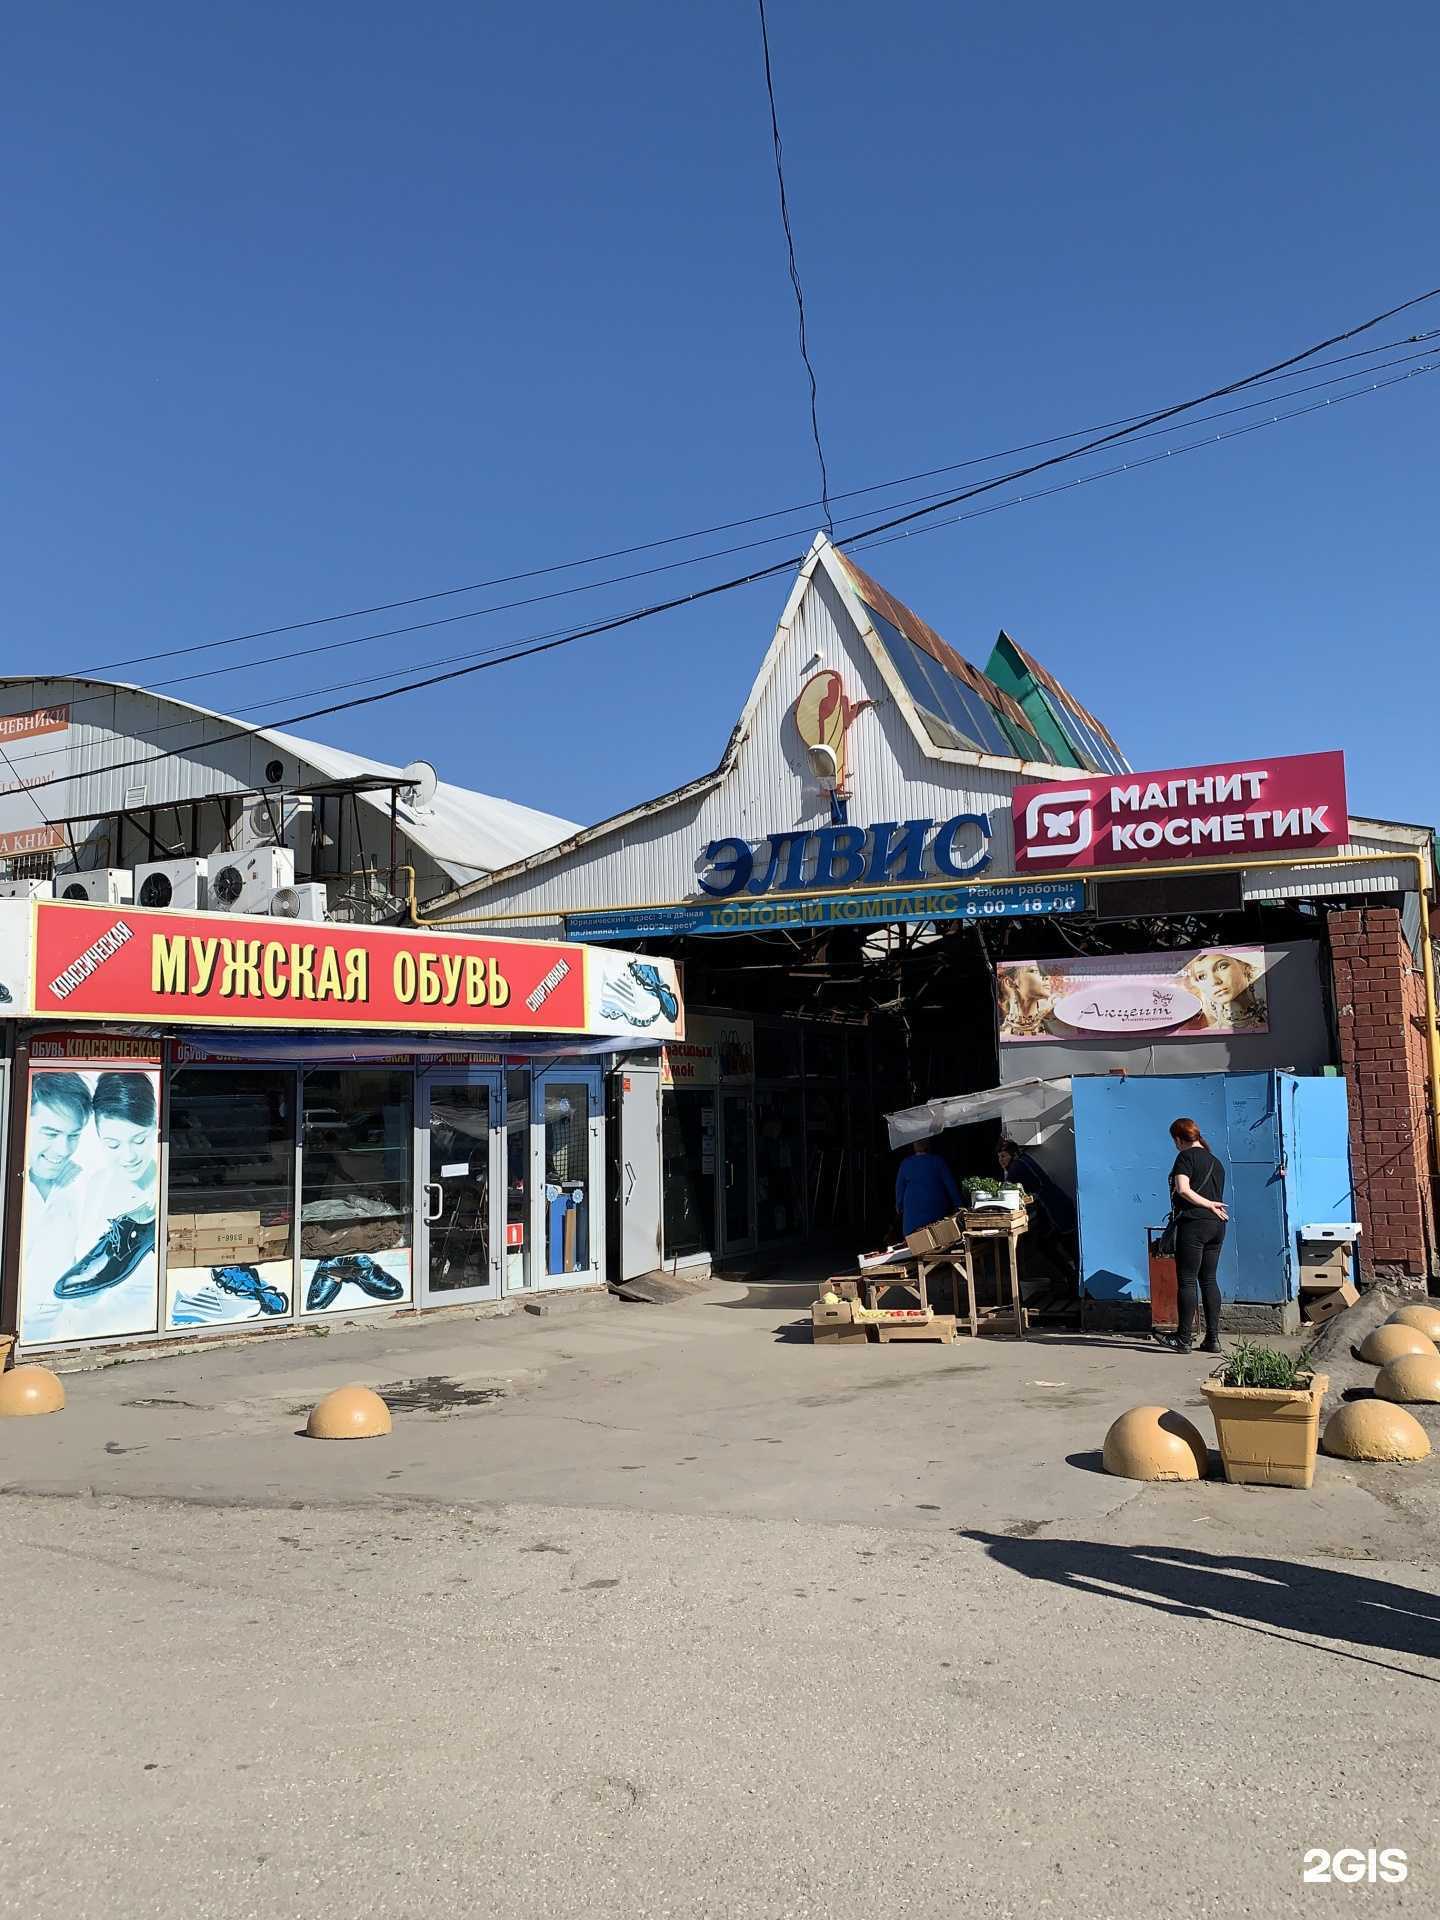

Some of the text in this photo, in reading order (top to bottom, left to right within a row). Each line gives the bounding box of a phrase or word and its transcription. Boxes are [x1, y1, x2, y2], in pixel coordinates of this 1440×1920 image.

[1111, 771, 1268, 813] МАГНИТ
[1112, 806, 1330, 851] КОСМЕТИК
[698, 812, 993, 897] ЭЛВИС
[711, 894, 959, 929] ТОРГОВЫЙ КОМПЛЕКС
[966, 900, 1006, 915] 8.00
[968, 883, 1074, 897] Режим работы:
[48, 920, 135, 1001] КЛАССИЧЕСКАЯ
[151, 933, 511, 1008] МУЖСКАЯ ОБУВЬ
[525, 958, 571, 1013] СПОРТИВНАЯ
[32, 1038, 161, 1058] ОБУВЬ КЛАССИЧЕСКАЯ
